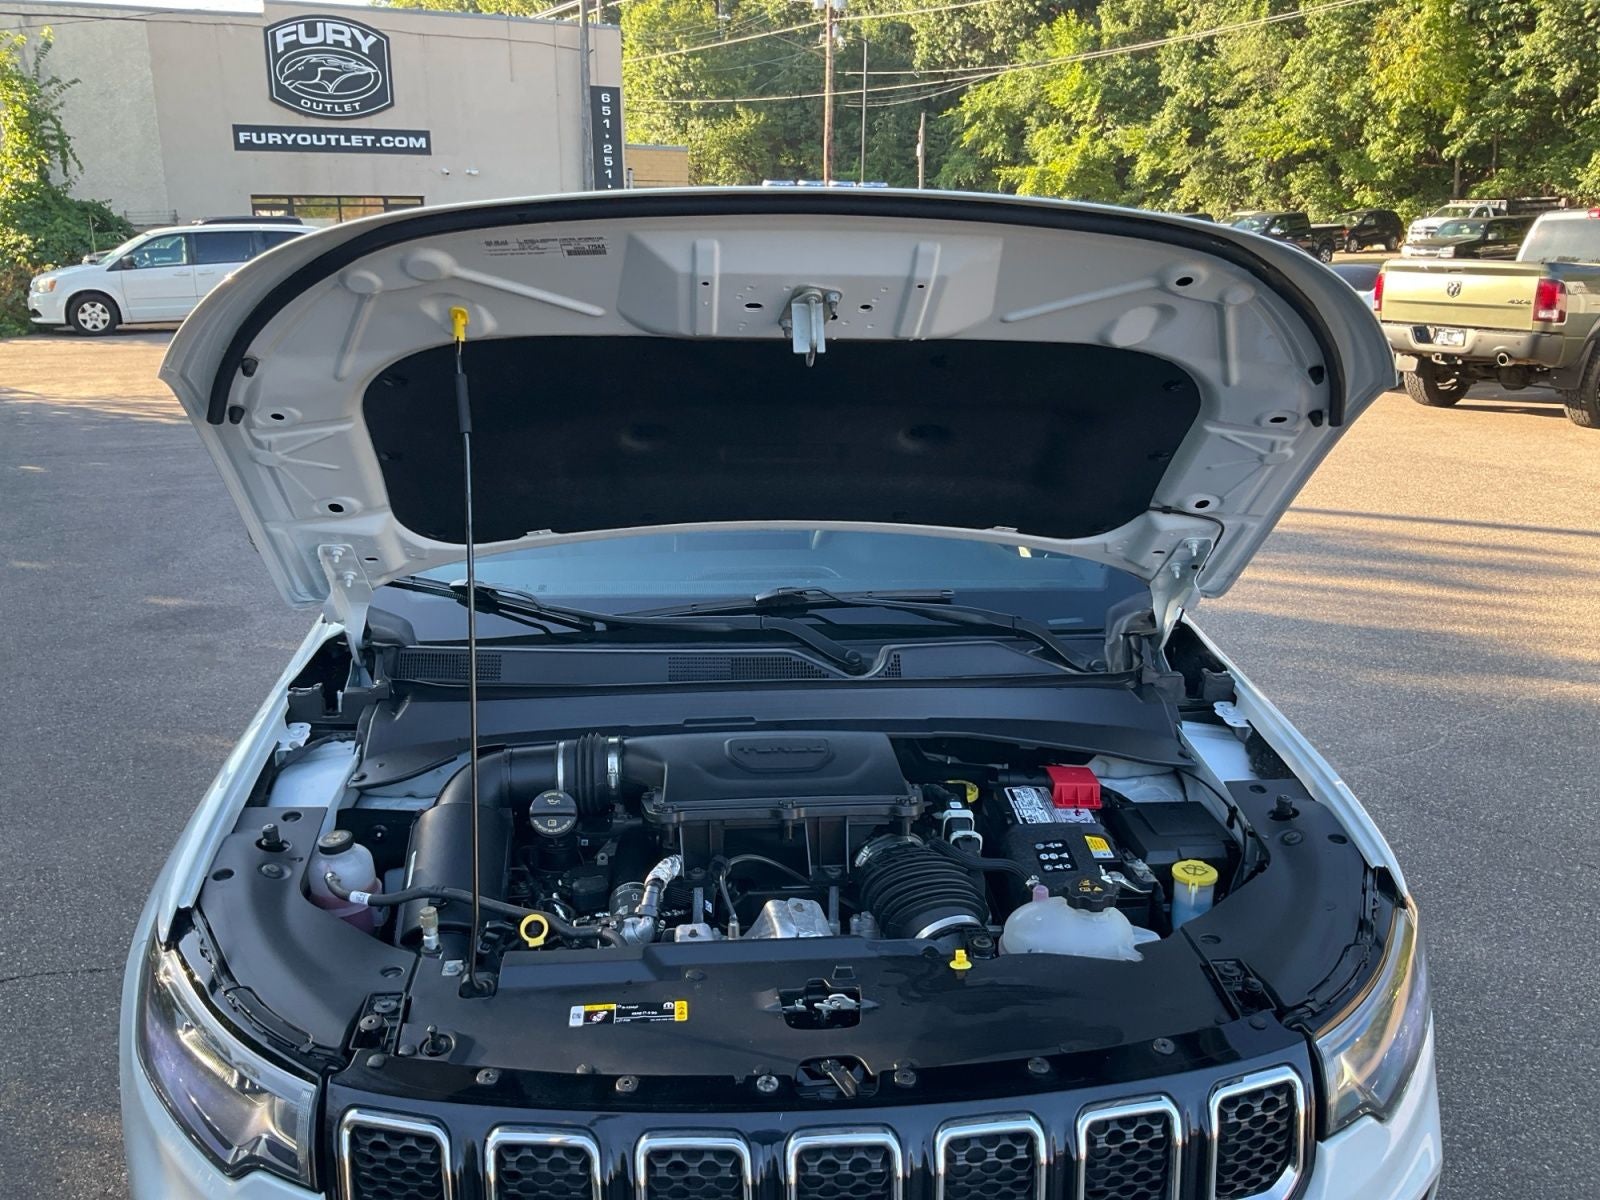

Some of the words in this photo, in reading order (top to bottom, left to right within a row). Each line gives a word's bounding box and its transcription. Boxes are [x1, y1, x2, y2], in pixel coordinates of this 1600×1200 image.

[276, 22, 377, 54] FURY
[300, 99, 361, 112] OUTLET
[238, 132, 427, 149] FURYOUTLET.COM
